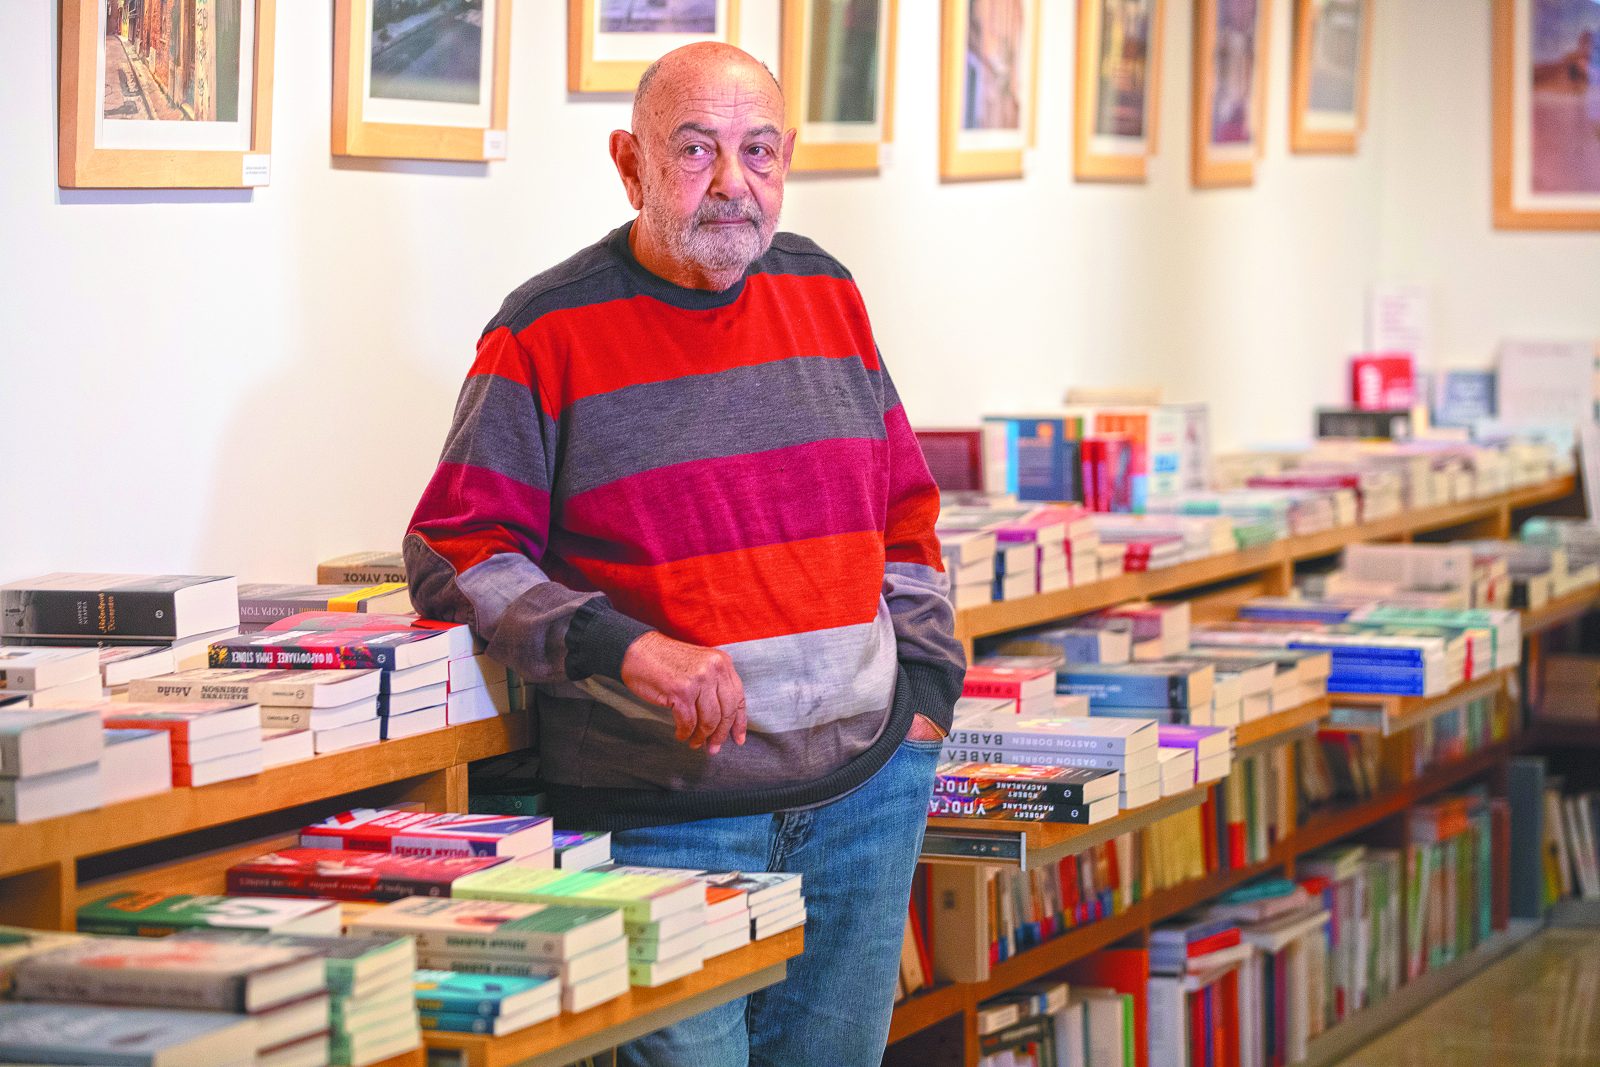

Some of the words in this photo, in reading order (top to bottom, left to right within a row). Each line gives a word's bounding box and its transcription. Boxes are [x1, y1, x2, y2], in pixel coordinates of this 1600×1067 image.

[343, 573, 381, 583] ΛΥΚΟΣ
[231, 651, 254, 663] STONEX
[256, 651, 274, 663] EMMA
[276, 651, 325, 664] ΦΑΡΟΦΥΛΑΚΕΣ
[200, 685, 249, 694] ROBINSON
[200, 692, 249, 700] MARILYNNE
[1012, 736, 1053, 747] DORREN
[1056, 738, 1096, 749] GASTON
[1012, 754, 1053, 766] DORREN
[1056, 756, 1096, 767] GASTON
[996, 782, 1048, 791] MACFARLANE
[1008, 790, 1038, 798] ROBERT
[1002, 802, 1054, 812] MACFARLANE
[1014, 810, 1045, 819] ROBERT
